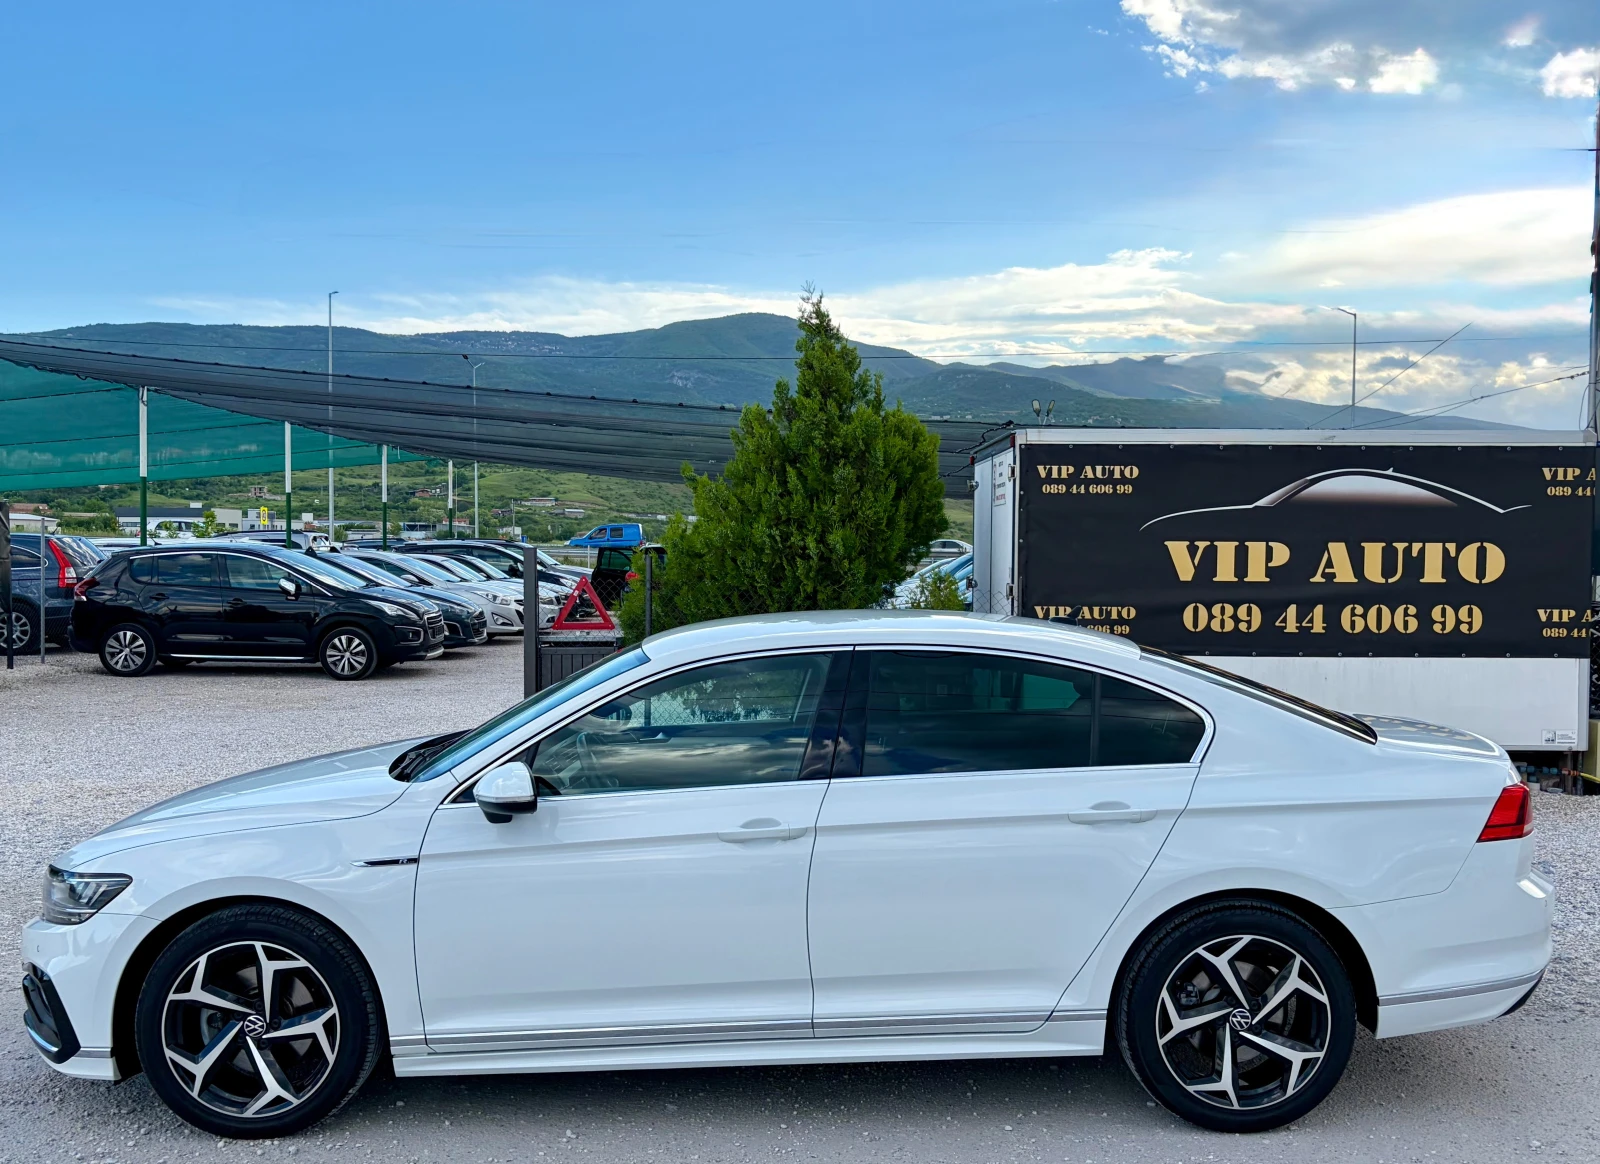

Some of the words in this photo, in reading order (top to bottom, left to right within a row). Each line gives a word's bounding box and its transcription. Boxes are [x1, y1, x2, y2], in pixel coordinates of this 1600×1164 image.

[1037, 465, 1075, 478] VIP
[1080, 465, 1139, 478] AUTO
[1541, 467, 1581, 480] VIP
[1042, 484, 1066, 494] 089
[1069, 484, 1085, 494] 44
[1089, 484, 1113, 494] 606
[1116, 484, 1133, 494] 99
[1546, 486, 1572, 496] 089
[1575, 486, 1591, 496] 44
[1164, 541, 1291, 582] VIP
[1309, 541, 1506, 584] AUTO
[1034, 605, 1073, 619] VIP
[1078, 606, 1137, 620] AUTO
[1182, 602, 1262, 633] 089
[1275, 603, 1327, 634] 44
[1340, 604, 1419, 634] 606
[1431, 604, 1483, 634] 99
[1536, 608, 1576, 622] VIP
[1113, 624, 1130, 635] 99
[1542, 627, 1567, 637] 089
[1570, 627, 1587, 637] 44
